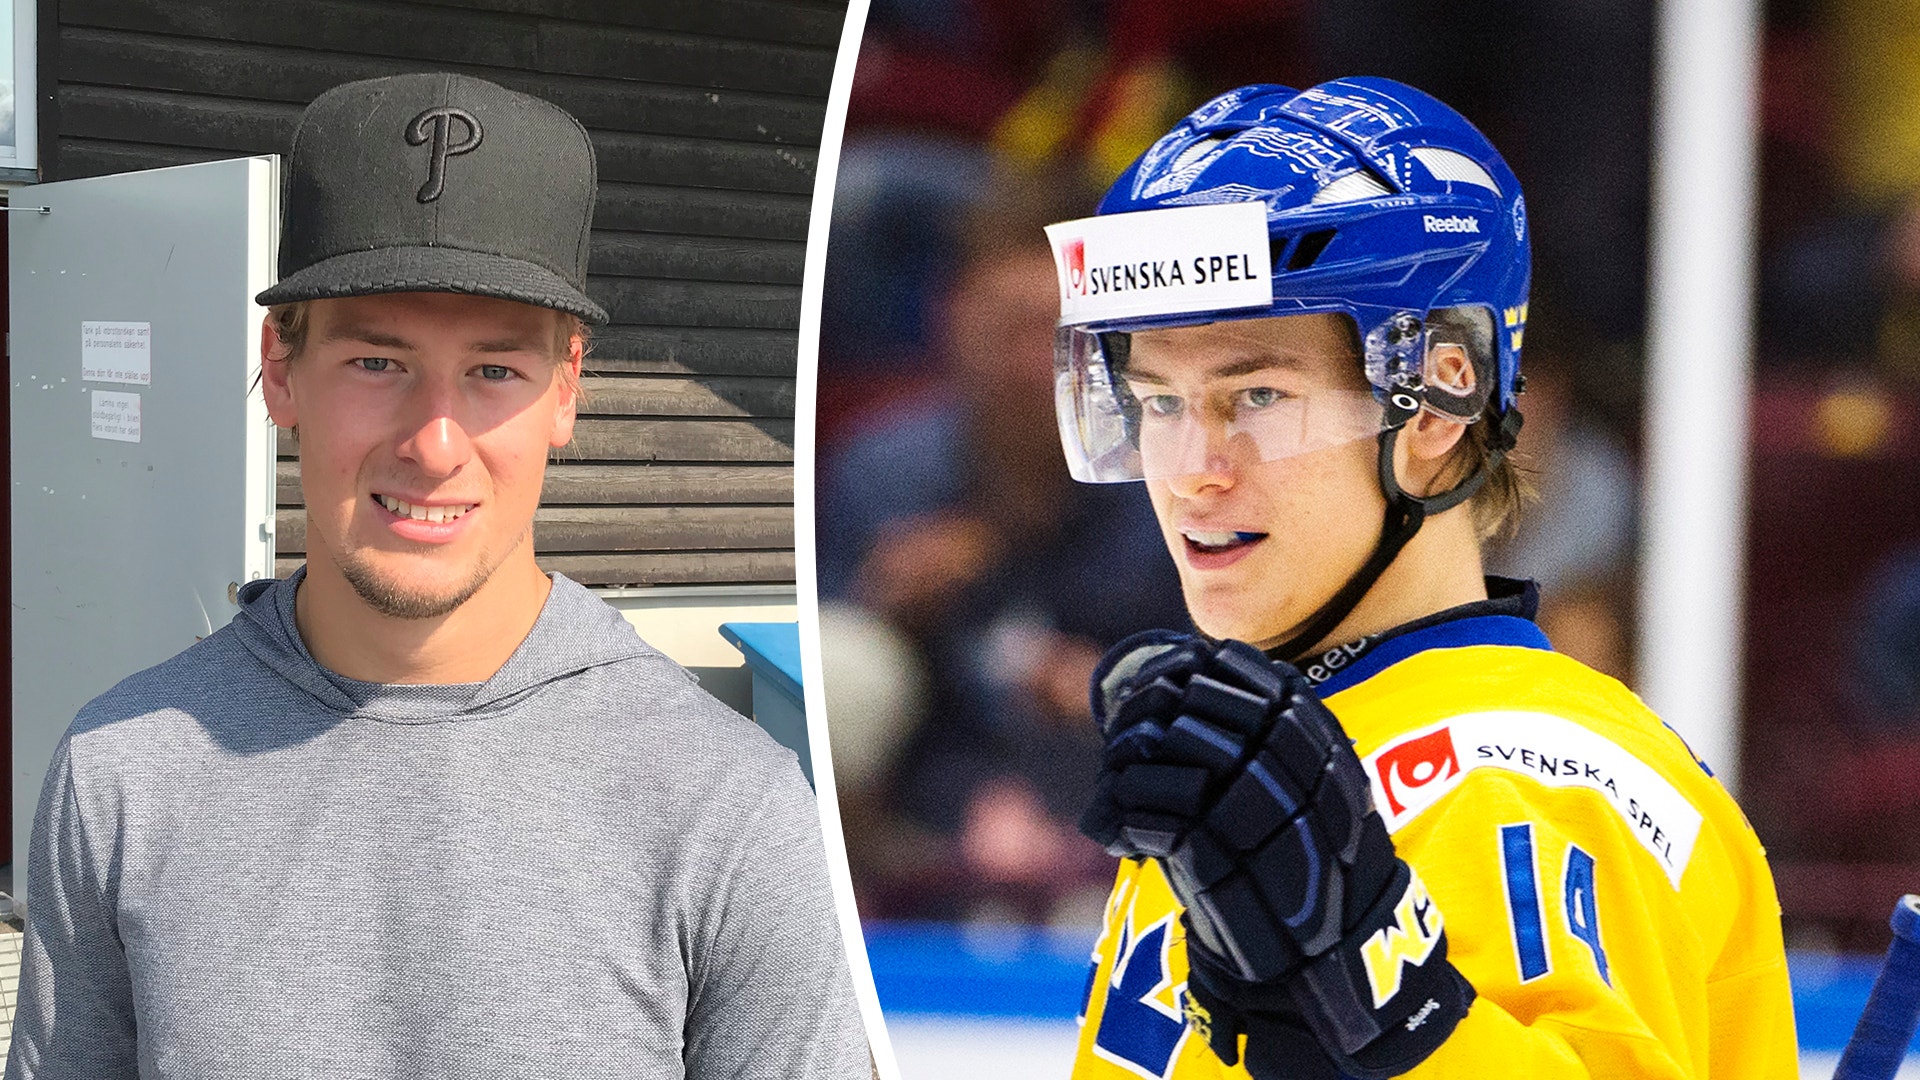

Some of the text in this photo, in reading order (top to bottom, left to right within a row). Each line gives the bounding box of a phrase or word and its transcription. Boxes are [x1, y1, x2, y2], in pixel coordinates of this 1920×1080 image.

[404, 106, 484, 204] P
[1423, 215, 1480, 233] Reebok
[1091, 254, 1257, 295] SVENSKA SPEL
[1477, 745, 1674, 868] SVENSKA SPEL
